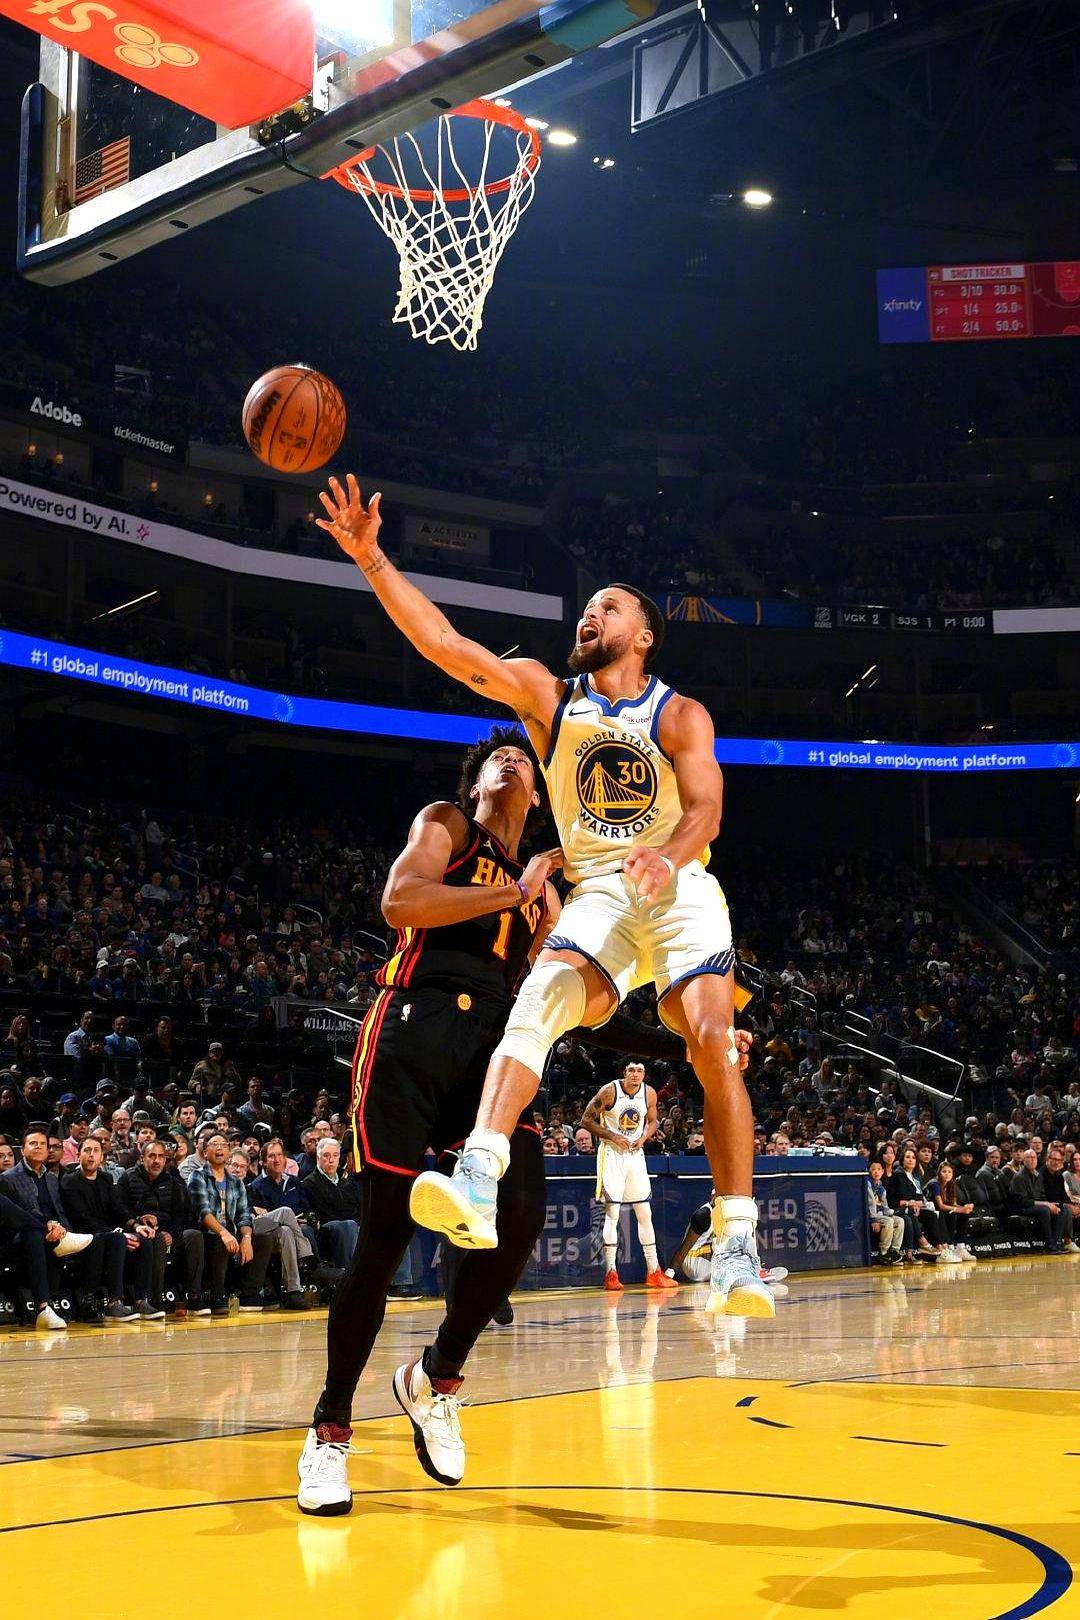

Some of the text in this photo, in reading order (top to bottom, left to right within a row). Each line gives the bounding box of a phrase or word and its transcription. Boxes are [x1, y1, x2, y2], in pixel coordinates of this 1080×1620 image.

[883, 299, 922, 312] xfinity
[964, 303, 979, 316] 1/4
[962, 321, 980, 334] 2/4
[30, 396, 82, 427] Adobe
[113, 425, 175, 454] ticketmaster
[82, 507, 103, 530] by
[108, 516, 130, 535] AI.
[843, 612, 867, 623] VGK
[872, 613, 880, 625] 2
[897, 616, 918, 626] SJS
[963, 616, 985, 628] 0:00
[30, 647, 250, 711] #1 global employment platform
[575, 731, 655, 758] GOLDEN STATE
[617, 761, 646, 785] 30
[807, 750, 1027, 770] #1 global employment platform
[579, 805, 661, 839] WARRIORS
[492, 911, 511, 958] 1
